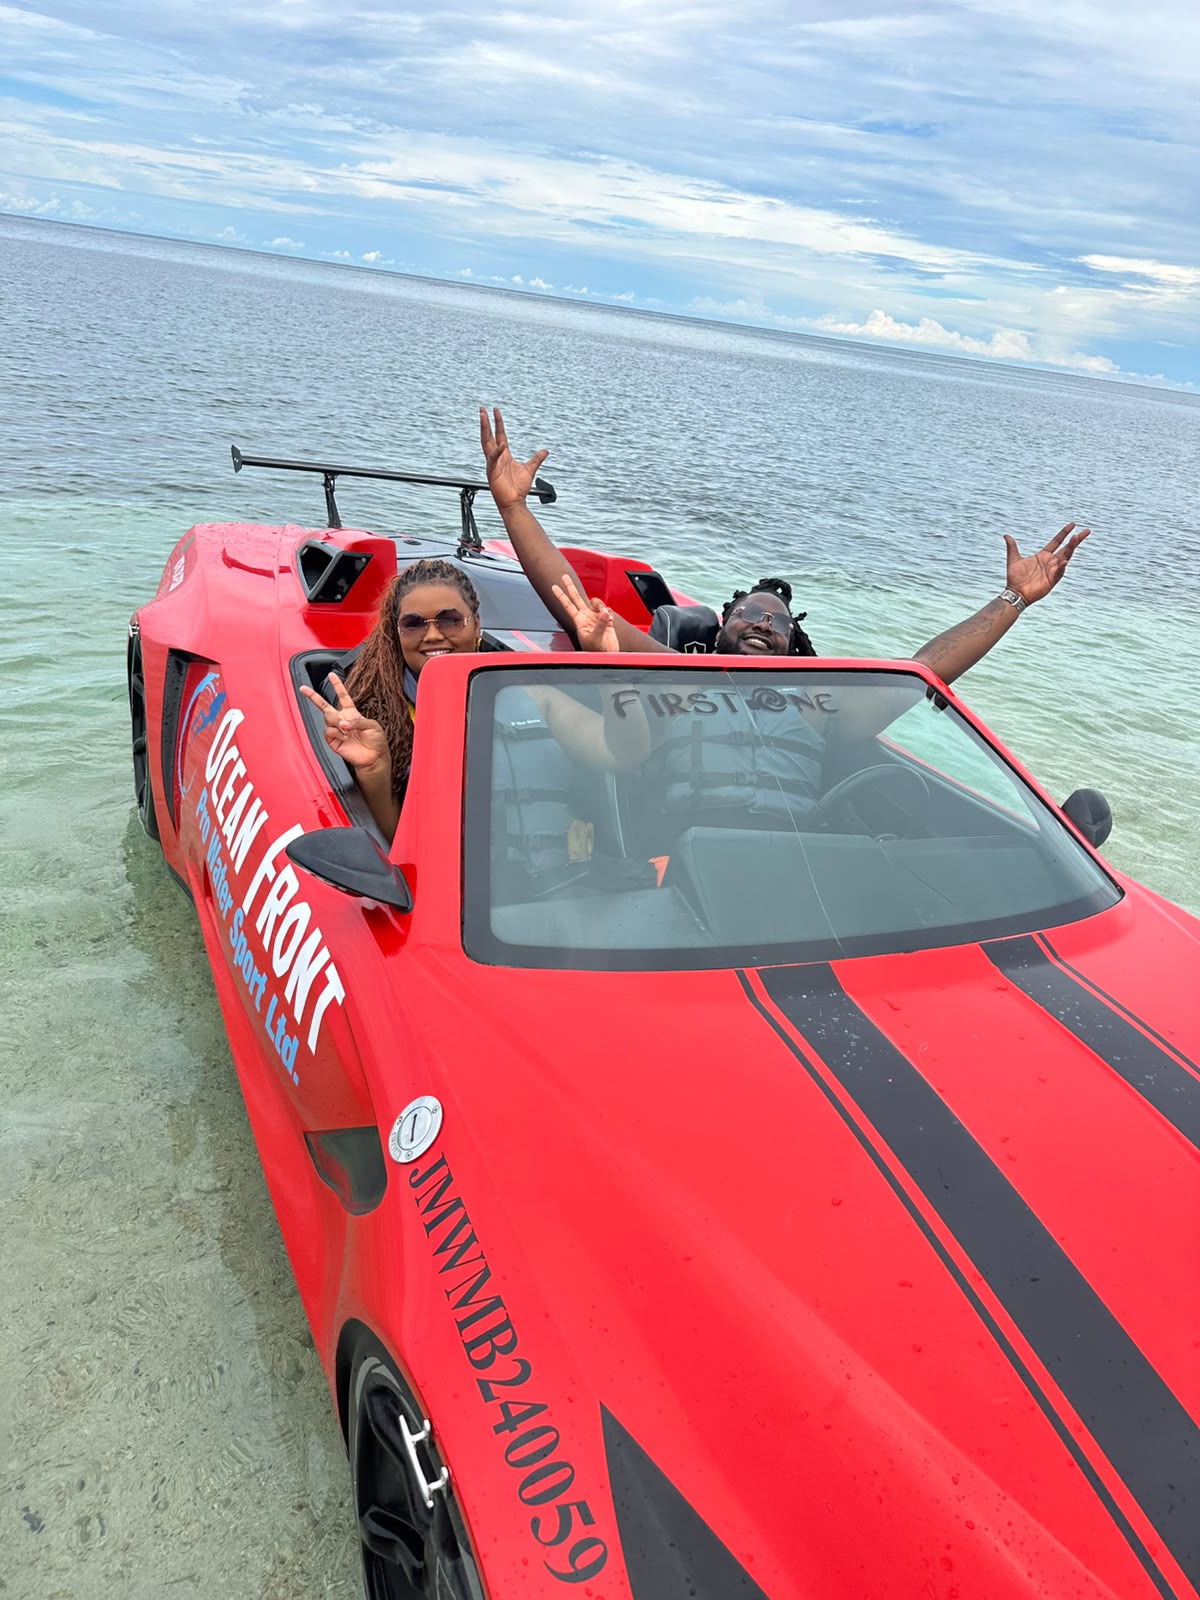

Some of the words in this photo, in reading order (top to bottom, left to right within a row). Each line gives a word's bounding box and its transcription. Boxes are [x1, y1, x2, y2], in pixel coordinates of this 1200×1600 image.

[611, 688, 738, 719] FIRST
[196, 787, 211, 845] Pro
[206, 833, 233, 920] Water
[229, 907, 268, 1012] Sport
[264, 993, 300, 1086] Ltd.
[205, 708, 269, 874] OCEAN
[242, 823, 345, 1056] FRONT
[408, 1151, 608, 1585] JMWMB240059
